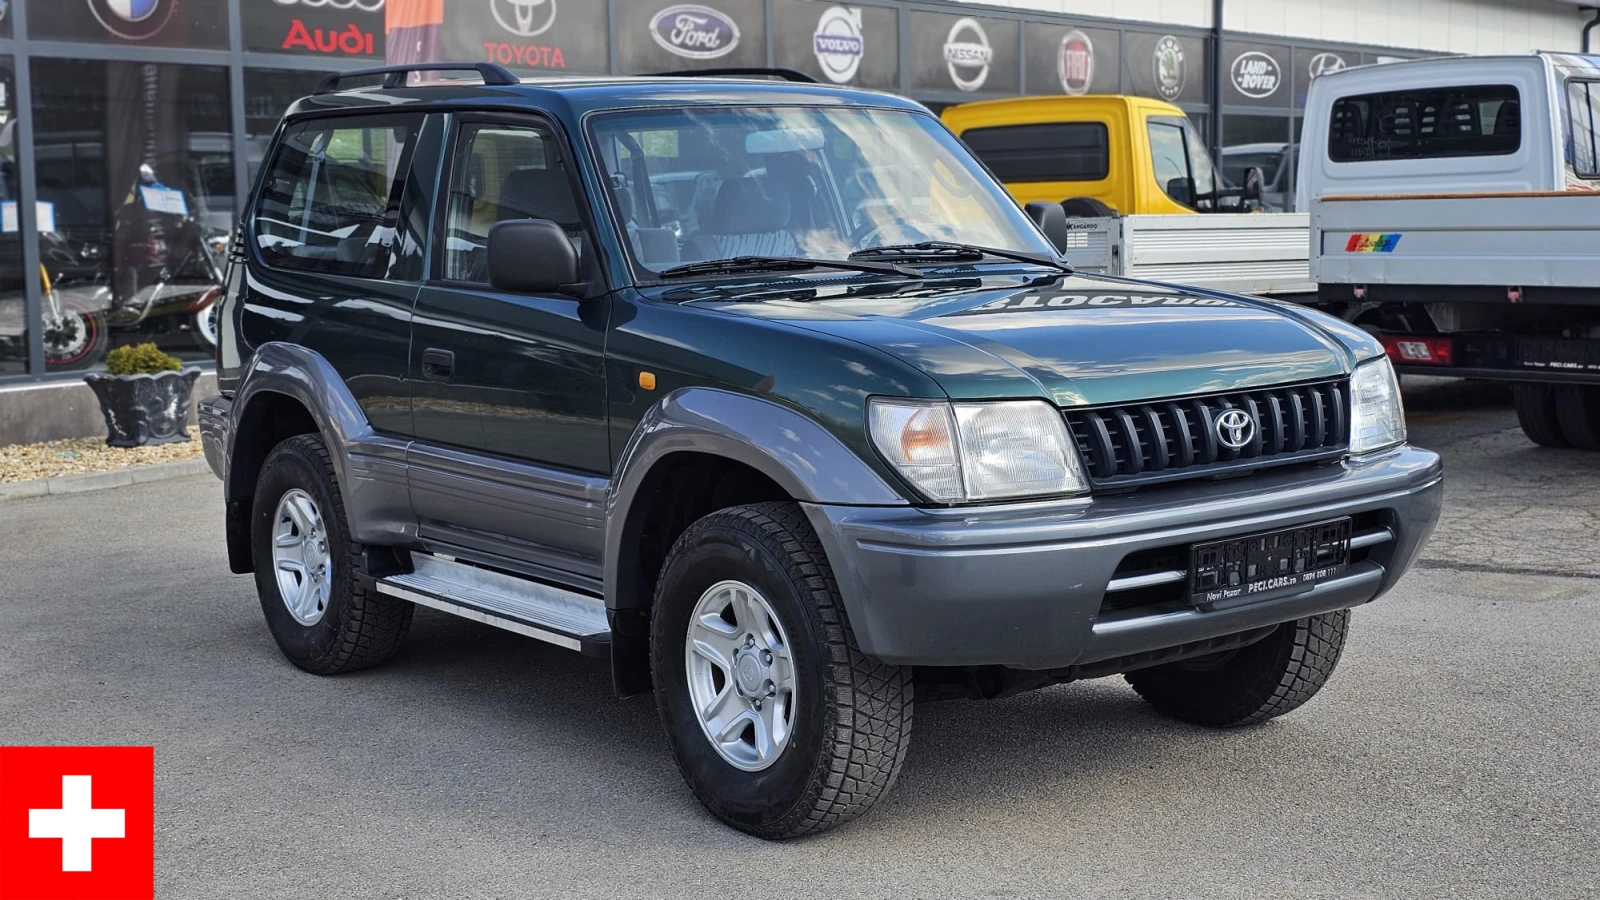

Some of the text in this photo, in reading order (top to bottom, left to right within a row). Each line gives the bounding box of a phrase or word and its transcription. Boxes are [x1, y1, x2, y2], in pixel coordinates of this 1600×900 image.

[282, 18, 373, 54] Audi
[671, 14, 720, 48] Ford
[483, 41, 567, 68] TOYOTA
[817, 38, 860, 52] VOLVO
[948, 48, 989, 61] NISSAN
[1066, 50, 1087, 80] FIAT
[1206, 590, 1222, 602] Novi
[1223, 588, 1241, 598] Pazar
